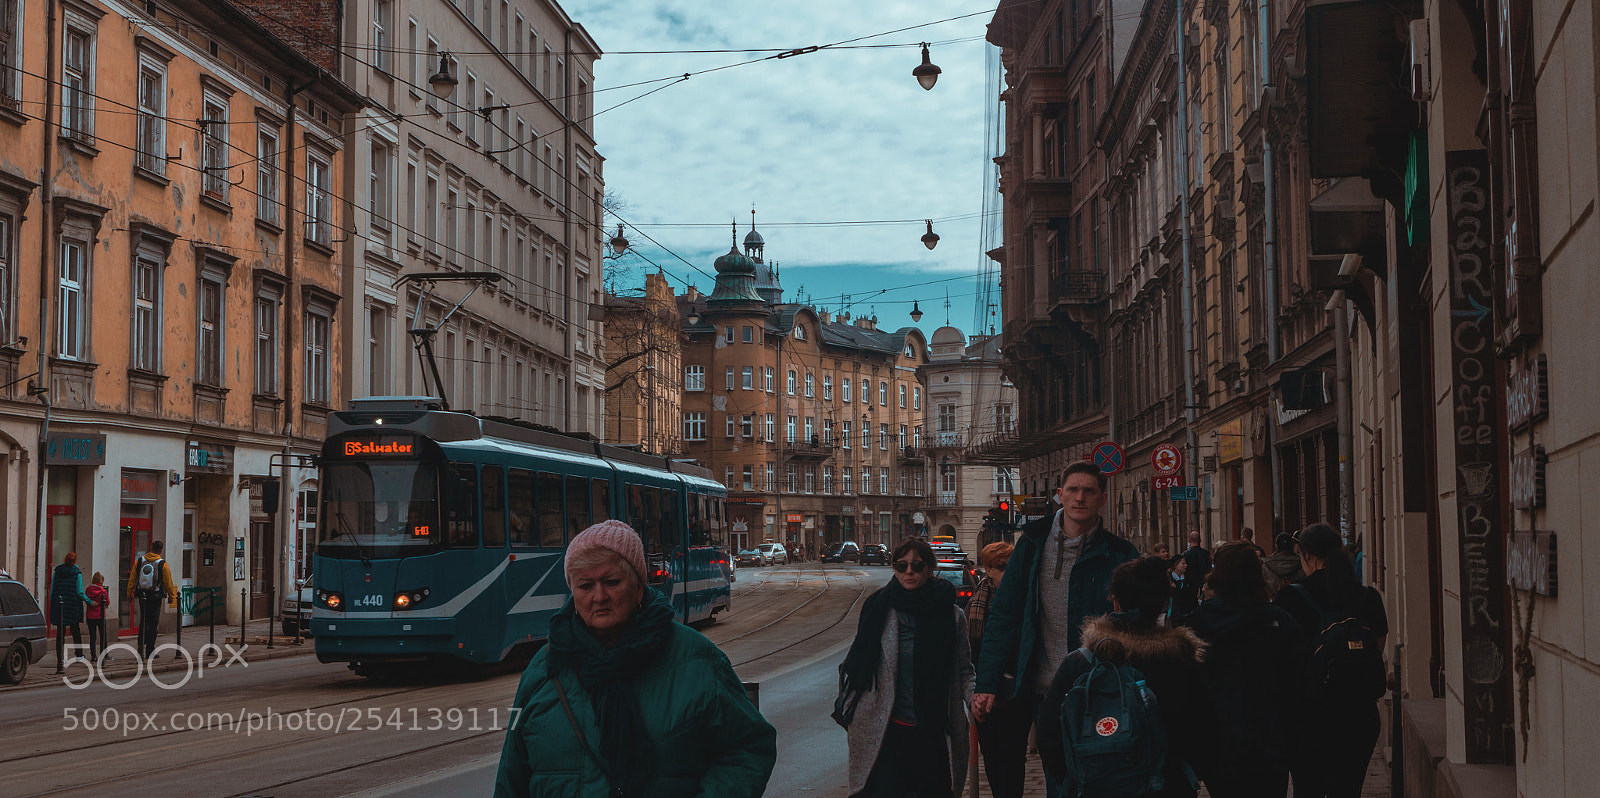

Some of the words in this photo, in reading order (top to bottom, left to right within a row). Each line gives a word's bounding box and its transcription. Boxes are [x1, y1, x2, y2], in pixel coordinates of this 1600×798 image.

[62, 438, 91, 460] INSIST
[353, 442, 412, 453] Salwator
[1155, 477, 1178, 489] 6-24
[363, 594, 383, 606] 440
